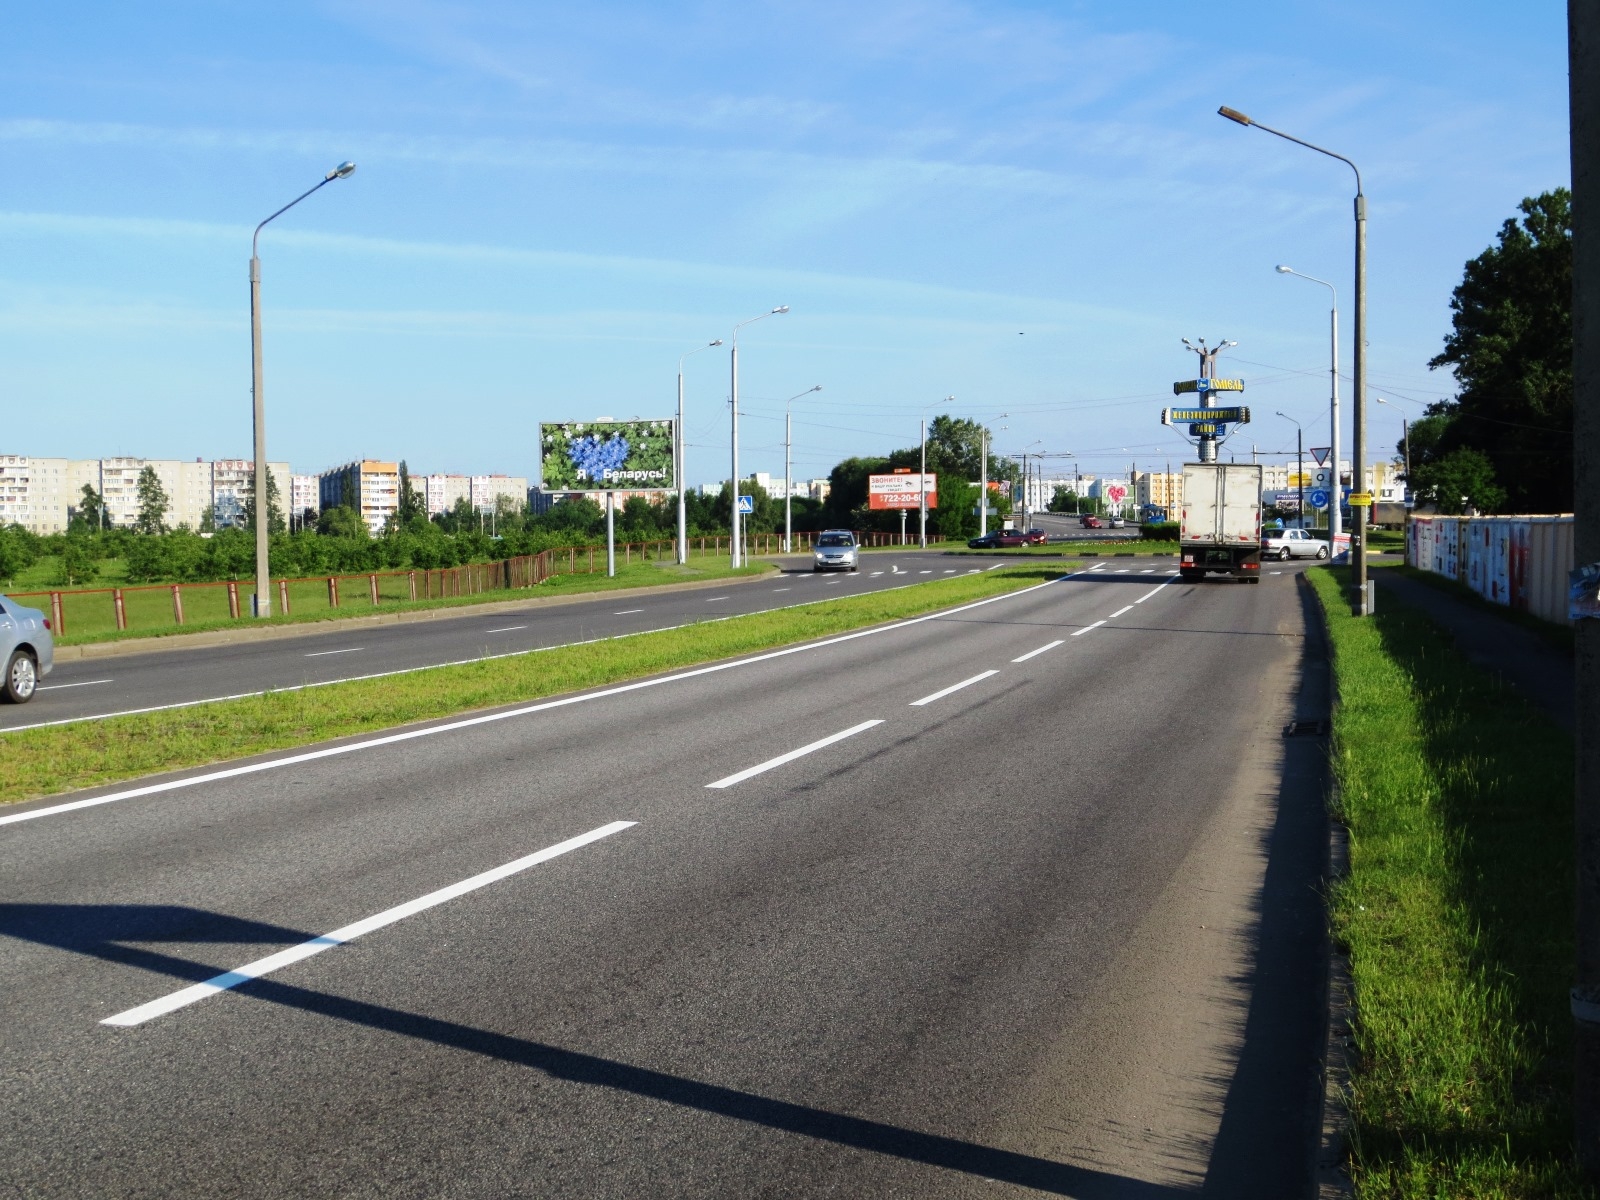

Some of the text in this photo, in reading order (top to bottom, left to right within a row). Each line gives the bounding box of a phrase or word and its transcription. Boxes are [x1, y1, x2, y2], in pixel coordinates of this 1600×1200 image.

[1210, 378, 1243, 390] ГОМЕЛЬ
[576, 468, 666, 480] Я Беларусь!
